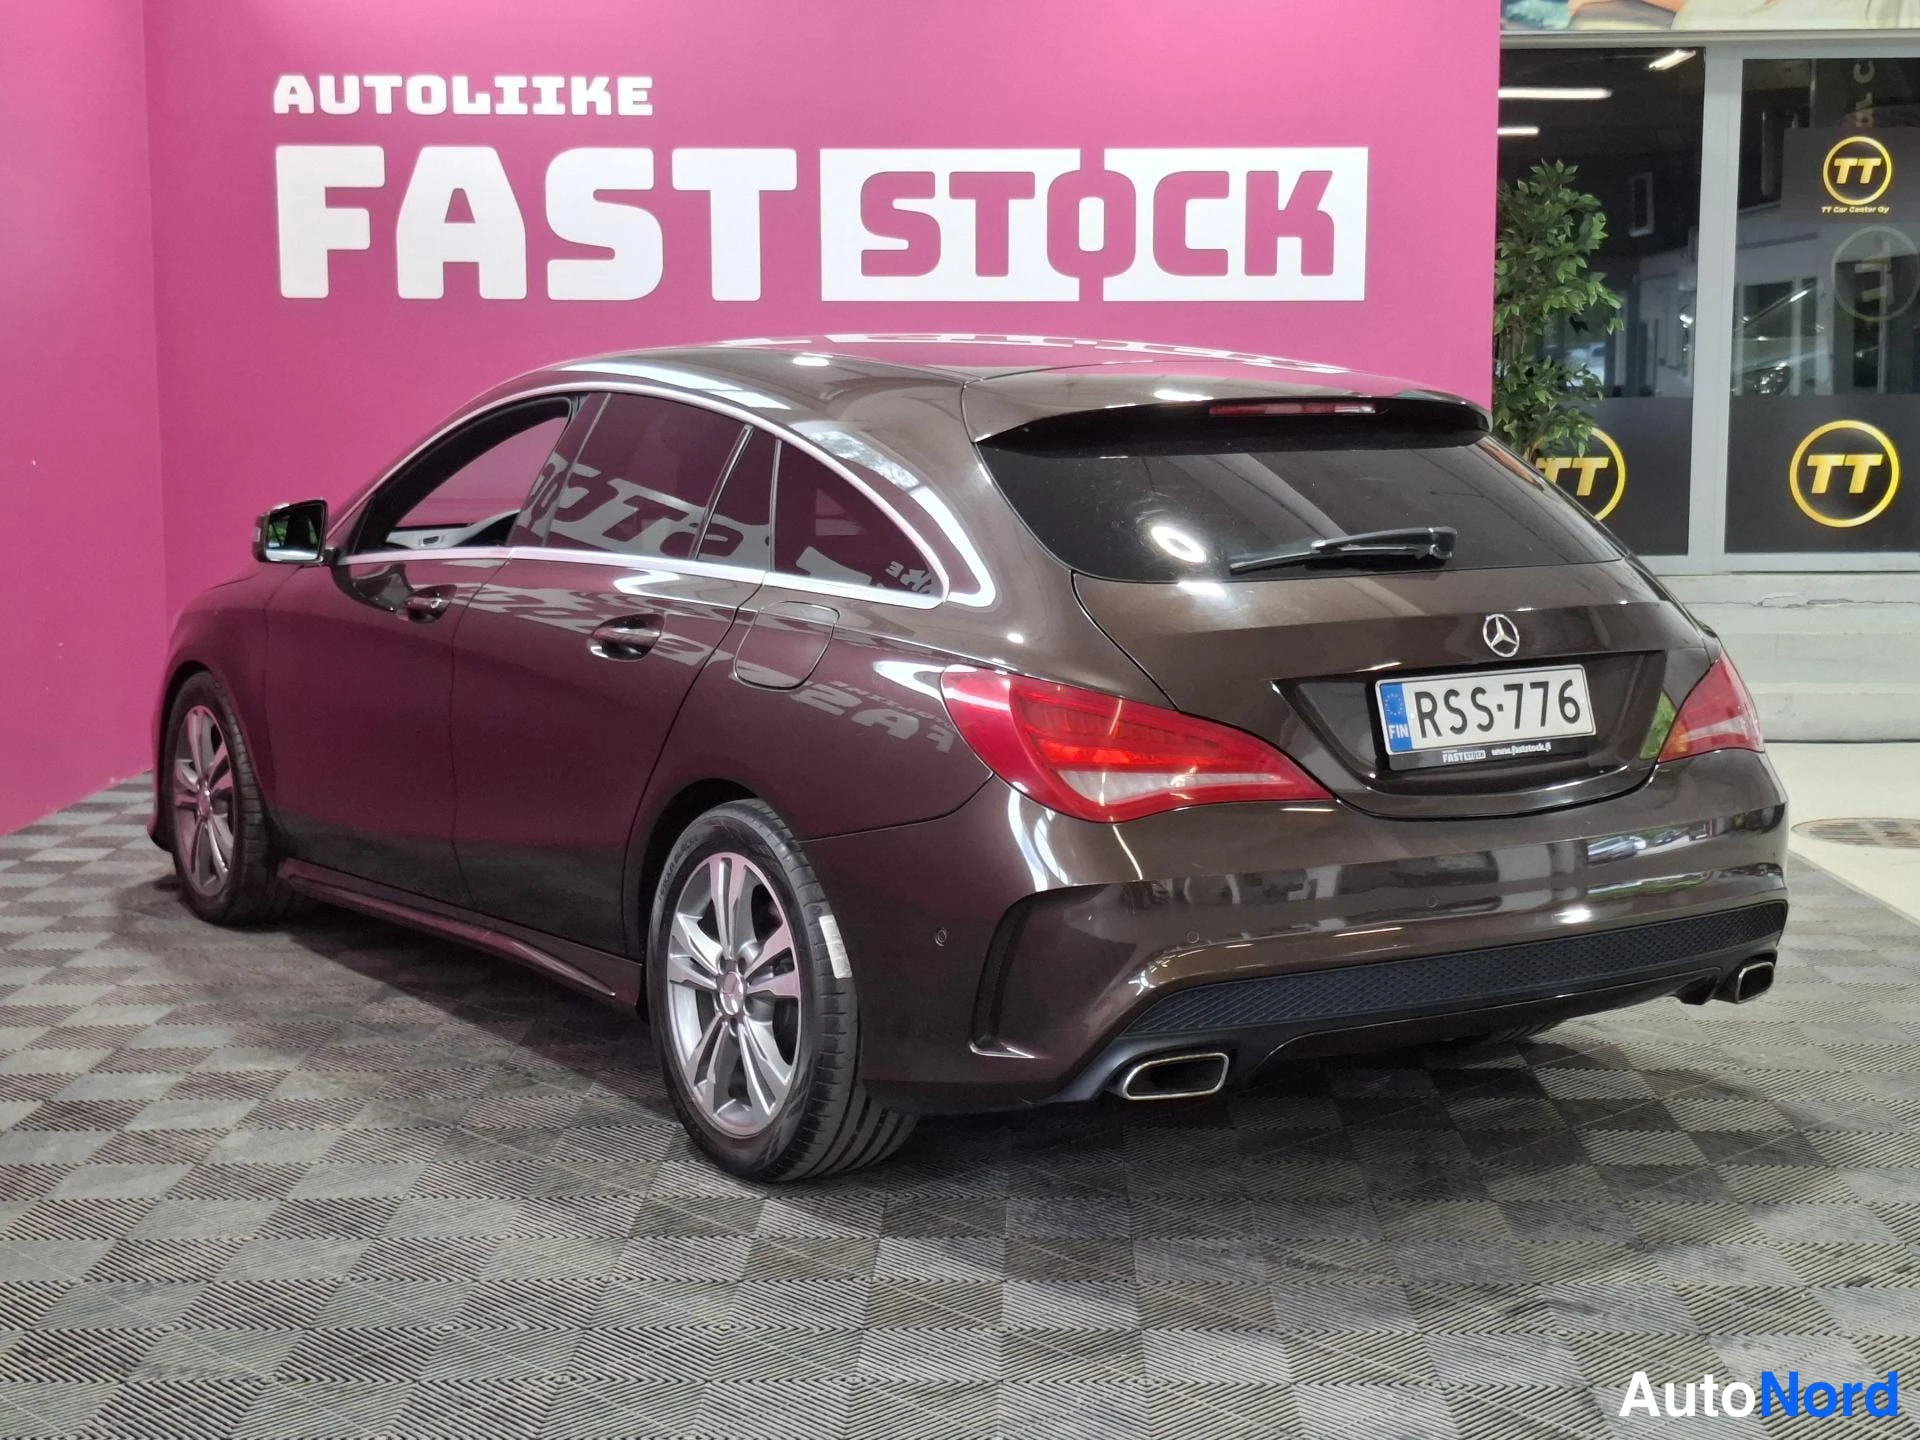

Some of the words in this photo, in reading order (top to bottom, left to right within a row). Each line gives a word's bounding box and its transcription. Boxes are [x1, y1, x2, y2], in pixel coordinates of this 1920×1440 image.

[273, 74, 654, 116] AUTOLIIKE
[1834, 157, 1882, 184] TT
[275, 145, 798, 301] FAST
[860, 169, 1336, 278] STOCK
[1833, 206, 1848, 214] Car
[1535, 456, 1609, 496] TT
[1807, 453, 1883, 494] TT
[1414, 679, 1581, 739] RSS-776
[1388, 724, 1410, 740] FIN
